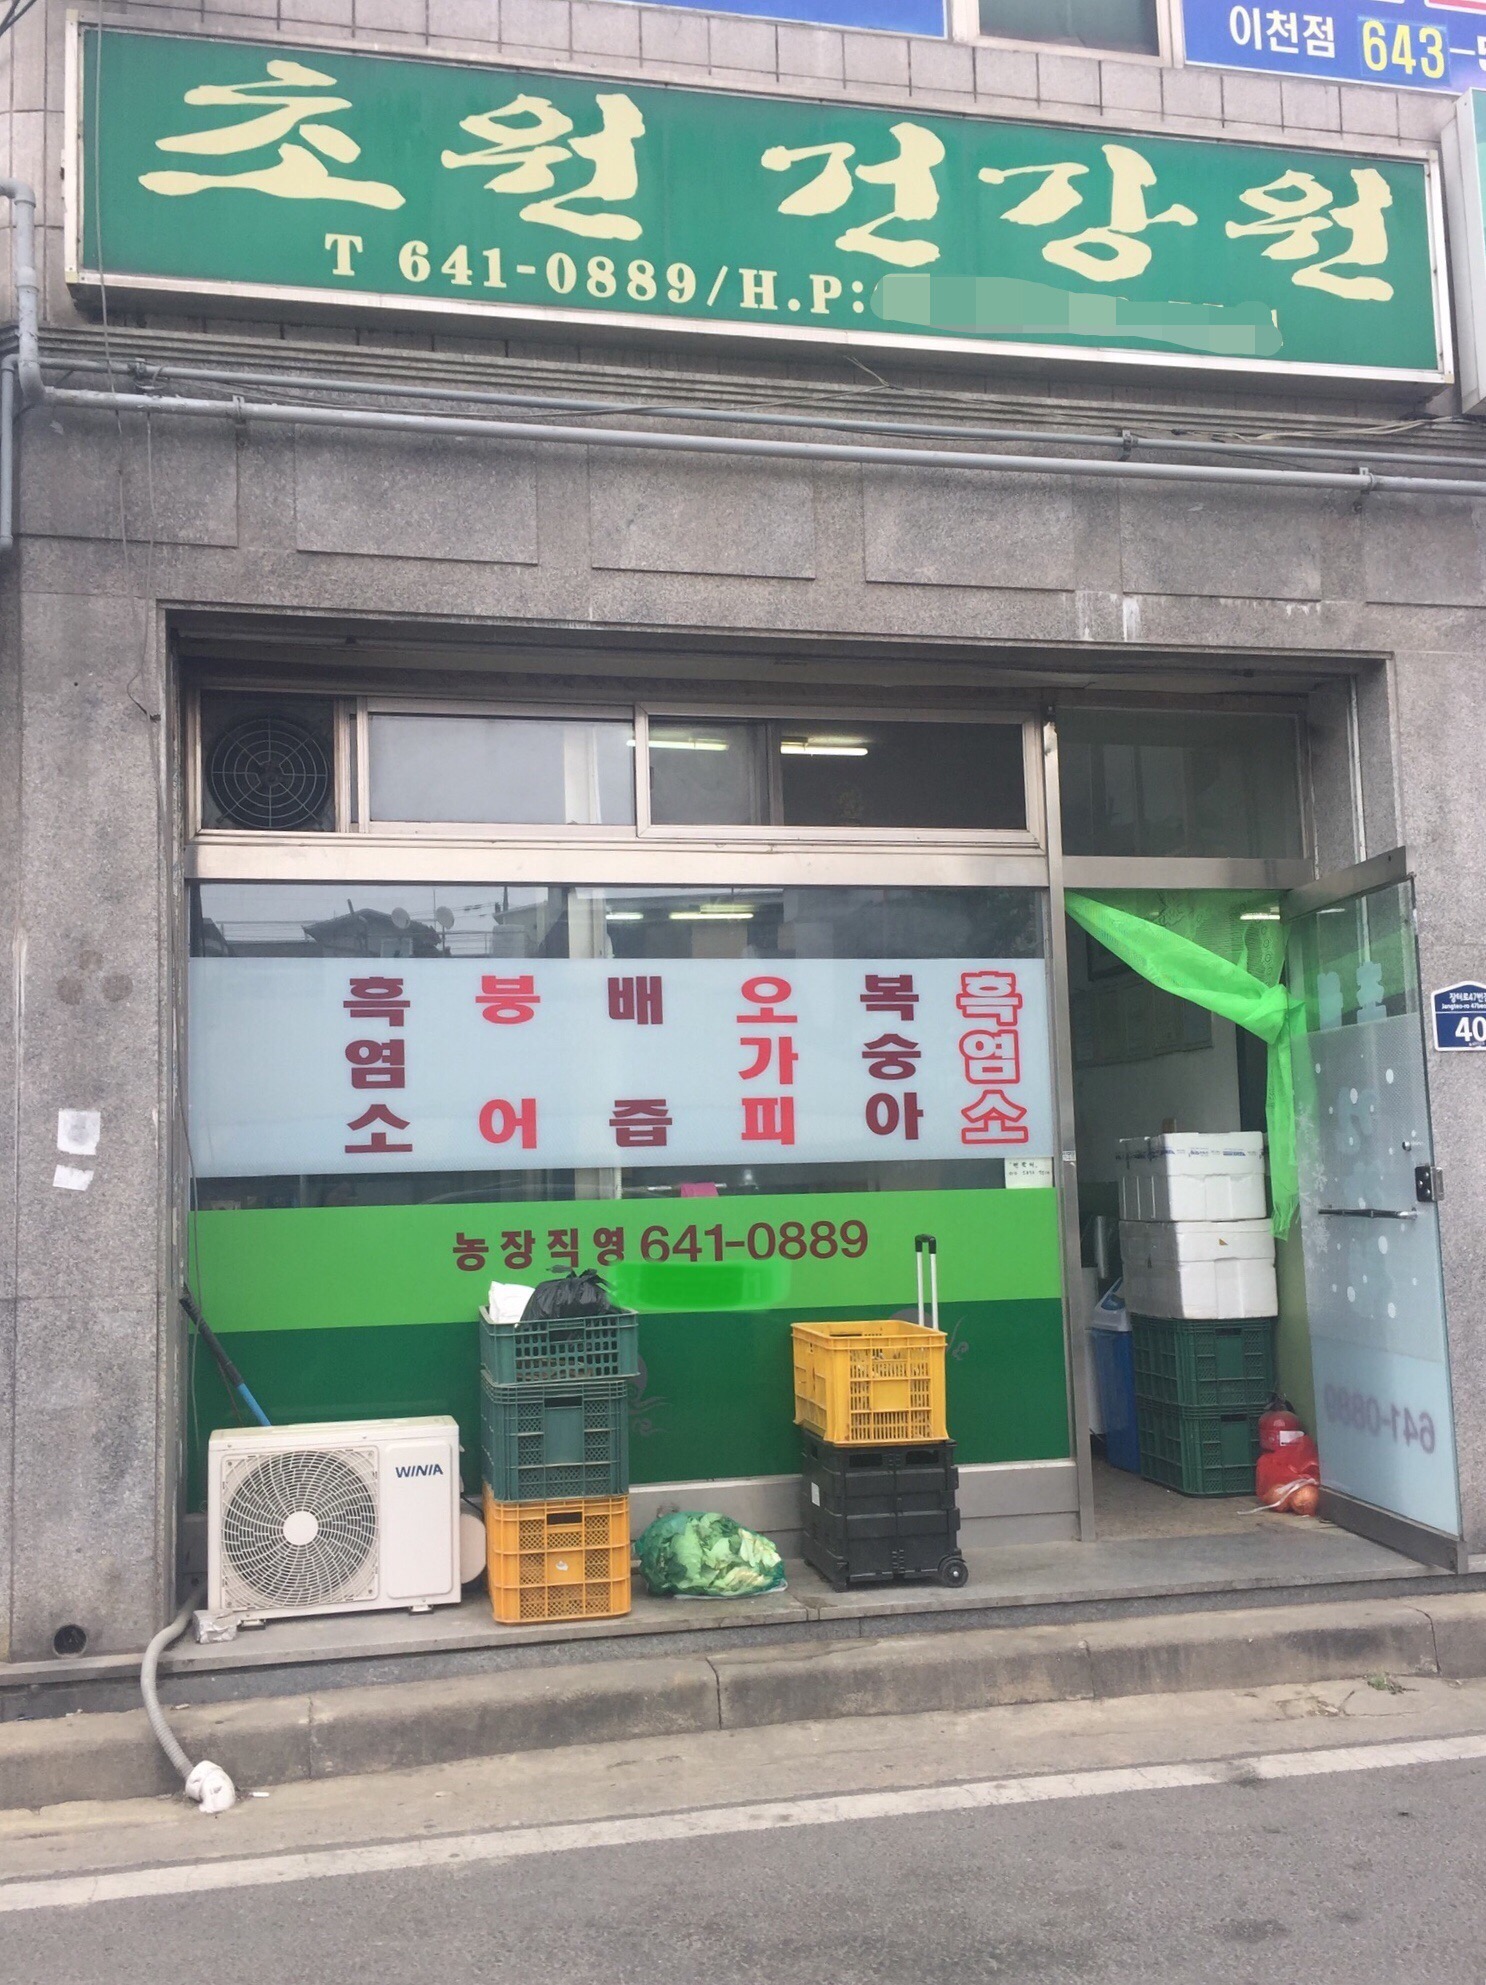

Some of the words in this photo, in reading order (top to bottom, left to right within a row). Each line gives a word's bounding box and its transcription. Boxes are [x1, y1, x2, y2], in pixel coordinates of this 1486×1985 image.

[1229, 5, 1335, 58] 이천점
[138, 59, 645, 241] 초원
[760, 121, 1394, 301] 건강원
[325, 233, 362, 276] T
[343, 976, 413, 1154] 흑염소
[475, 975, 541, 1149] 붕어
[608, 976, 672, 1147] 배즙
[736, 976, 799, 1145] 오가피
[860, 974, 924, 1140] 복숭아
[955, 971, 1029, 1144] 흑염소
[452, 1226, 625, 1271] 농장직영
[640, 1220, 868, 1263] 641-0889
[395, 1463, 444, 1478] WINIA
